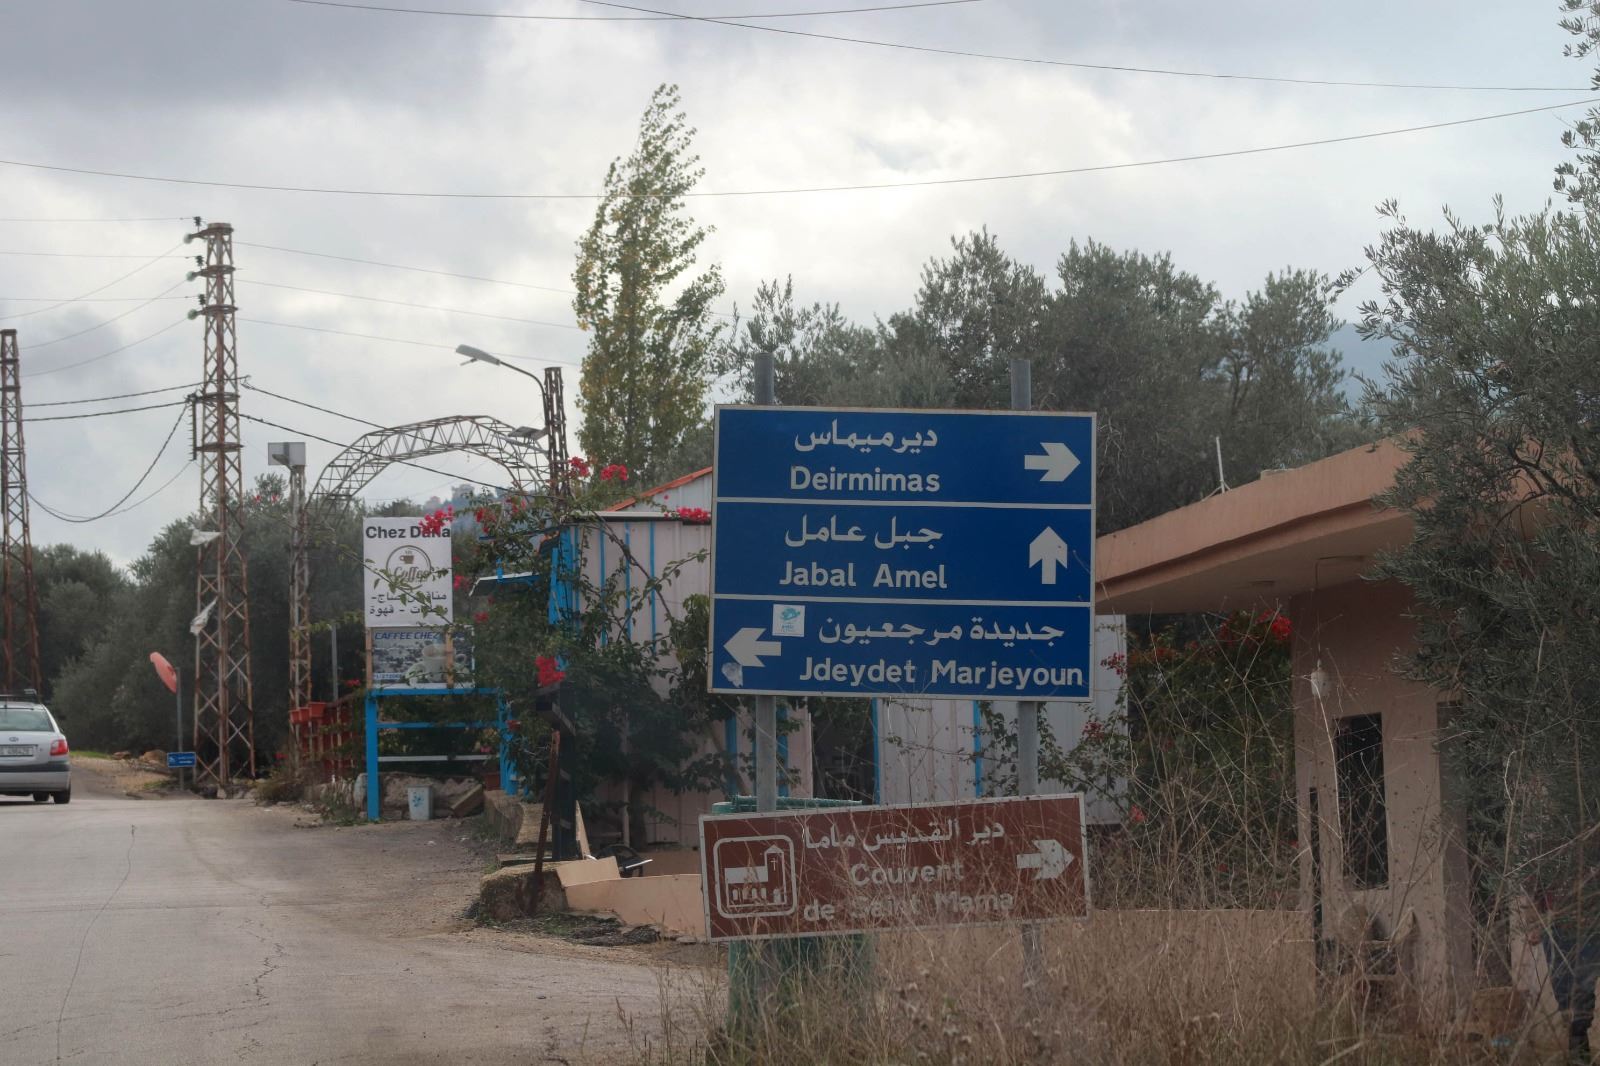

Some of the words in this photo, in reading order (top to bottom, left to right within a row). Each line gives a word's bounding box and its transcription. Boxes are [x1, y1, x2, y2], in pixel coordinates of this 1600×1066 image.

[790, 466, 940, 492] Deirmimas
[365, 525, 406, 539] Chez
[785, 514, 866, 547] عامل
[874, 516, 943, 550] جبل
[779, 561, 857, 587] Jabal
[873, 563, 947, 589] Amel
[819, 617, 963, 646] مرجعيون
[970, 617, 1065, 647] جديدة
[799, 657, 916, 687] Jdeydet
[931, 660, 1083, 690] Marjeyoun
[805, 823, 855, 849] ماما
[863, 818, 960, 852] القديس
[966, 822, 1005, 846] دير
[850, 861, 964, 887] Couvent
[803, 898, 836, 922] de
